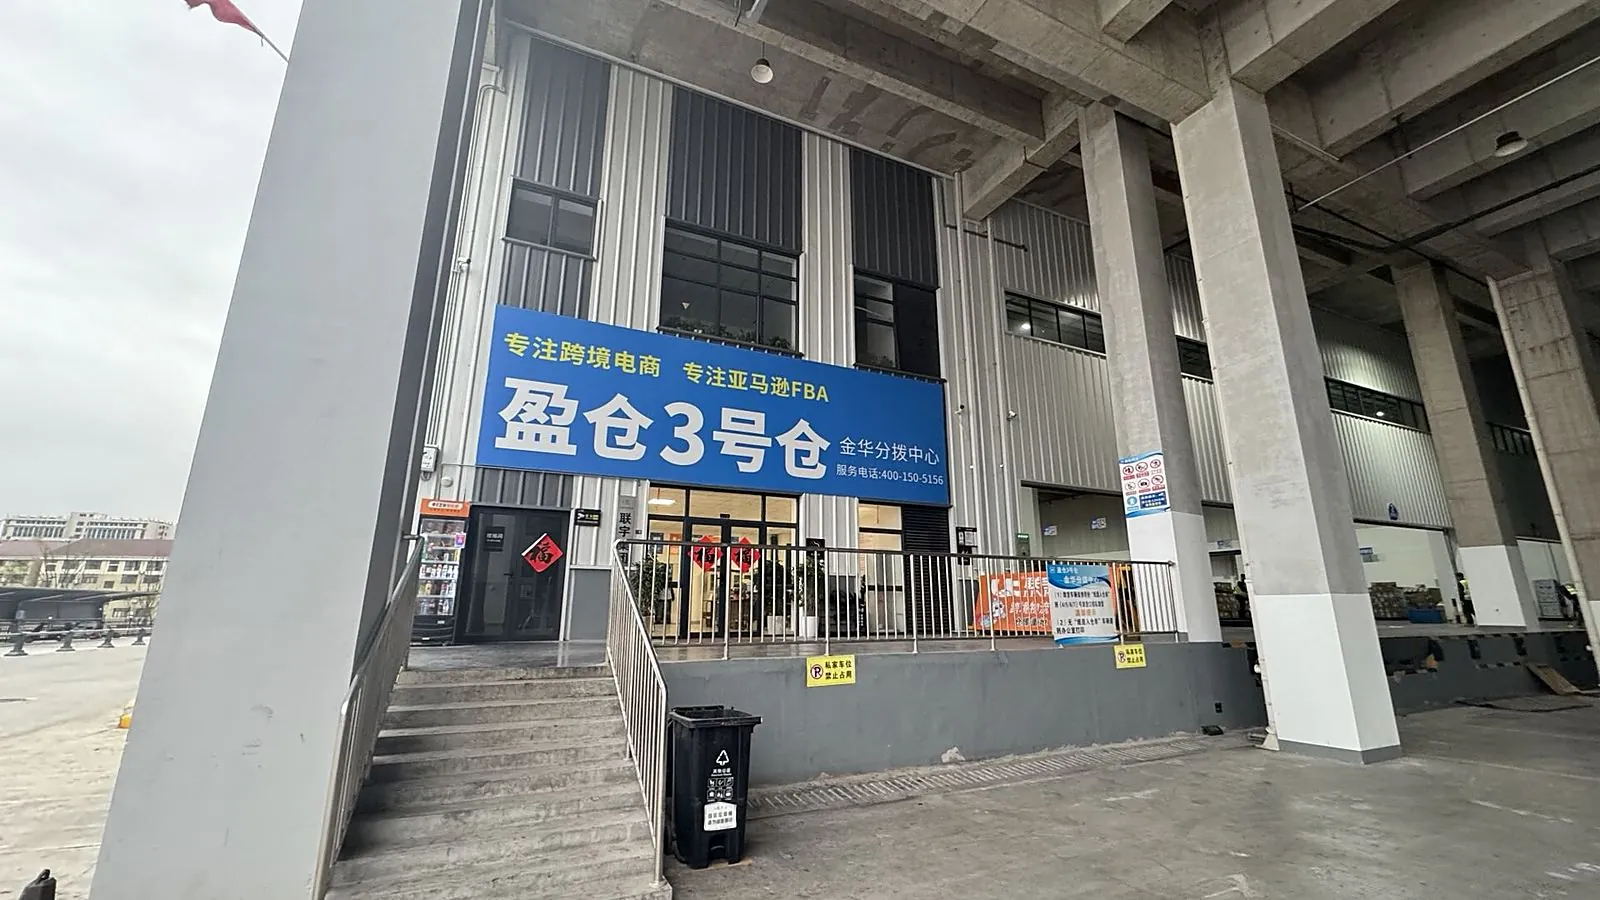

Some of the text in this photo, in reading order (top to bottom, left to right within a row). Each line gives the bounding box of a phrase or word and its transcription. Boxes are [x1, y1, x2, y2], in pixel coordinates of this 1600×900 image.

[504, 332, 829, 402] 专注跨境电商 专注亚马逊FBA
[495, 377, 831, 479] 盈仓3号仓
[839, 436, 940, 465] 金华分拨中心
[836, 463, 944, 486] 服务电话:400-150-5156
[529, 541, 554, 564] 福
[825, 660, 852, 669] 私家车位
[825, 671, 852, 680] 禁止占用
